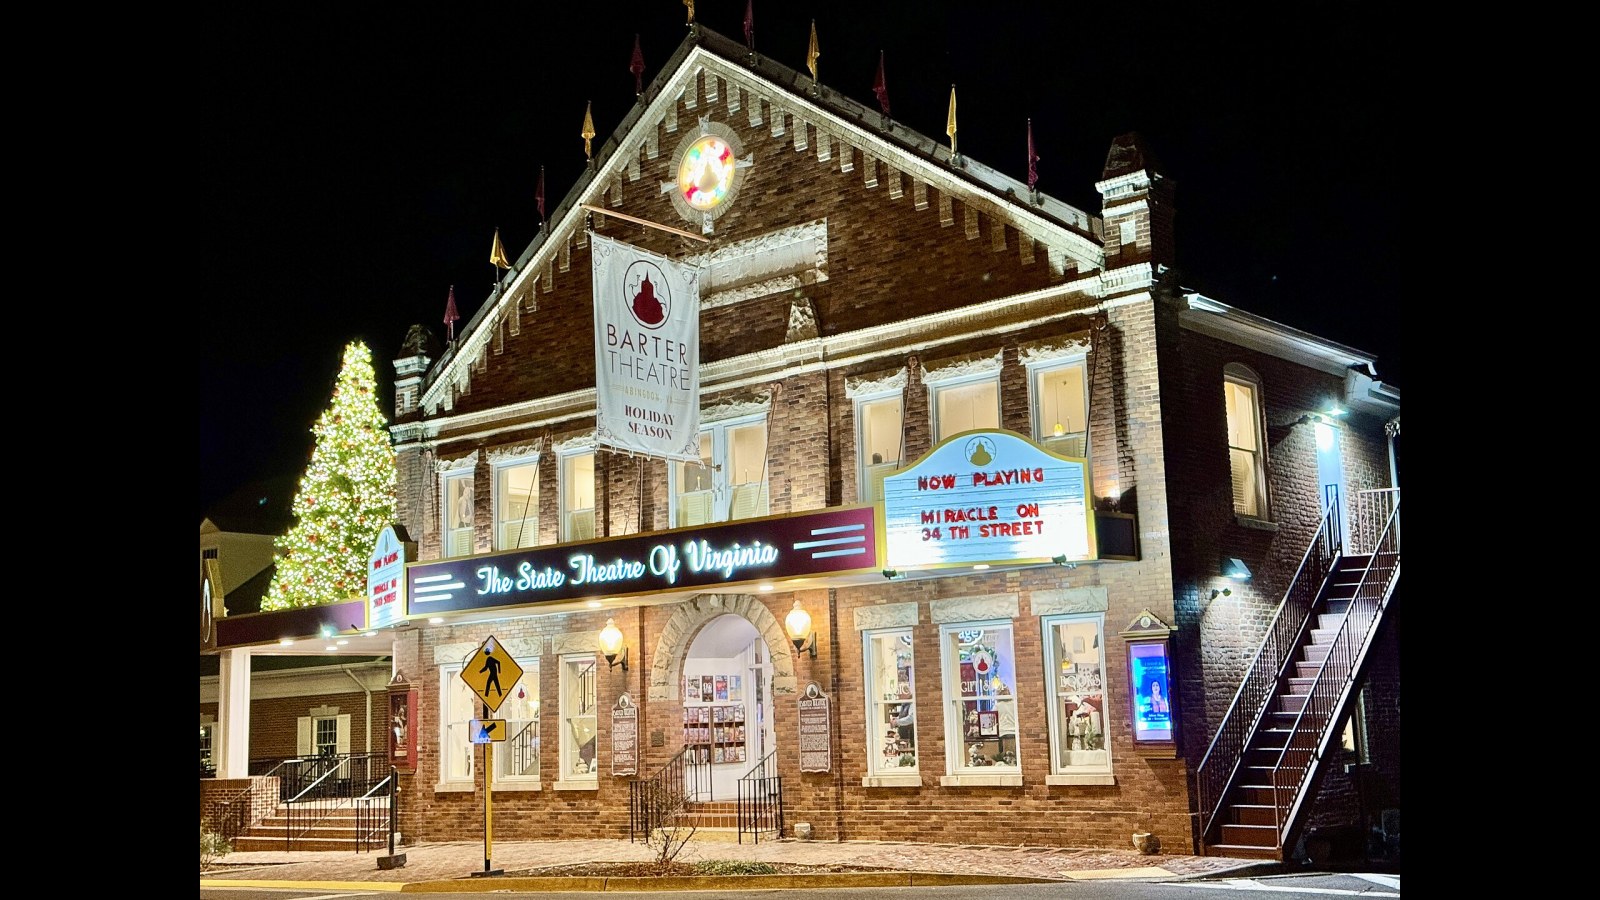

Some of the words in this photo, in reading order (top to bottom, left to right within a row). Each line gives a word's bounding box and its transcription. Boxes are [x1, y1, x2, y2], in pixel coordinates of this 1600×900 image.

[607, 323, 688, 365] BARTER
[608, 350, 691, 391] THEATRE
[625, 404, 675, 426] HOLIDAY
[628, 421, 672, 440] SEASON
[918, 473, 957, 491] NOW
[973, 467, 1044, 487] PLAYING
[921, 505, 999, 525] MIRACLE
[1016, 502, 1040, 518] ON
[921, 528, 942, 541] 34
[949, 525, 970, 539] TH
[980, 519, 1044, 538] STREET
[477, 565, 514, 595] The
[517, 561, 566, 591] State
[571, 554, 646, 585] Theatre
[649, 543, 680, 584] Of
[687, 539, 778, 579] Virginia
